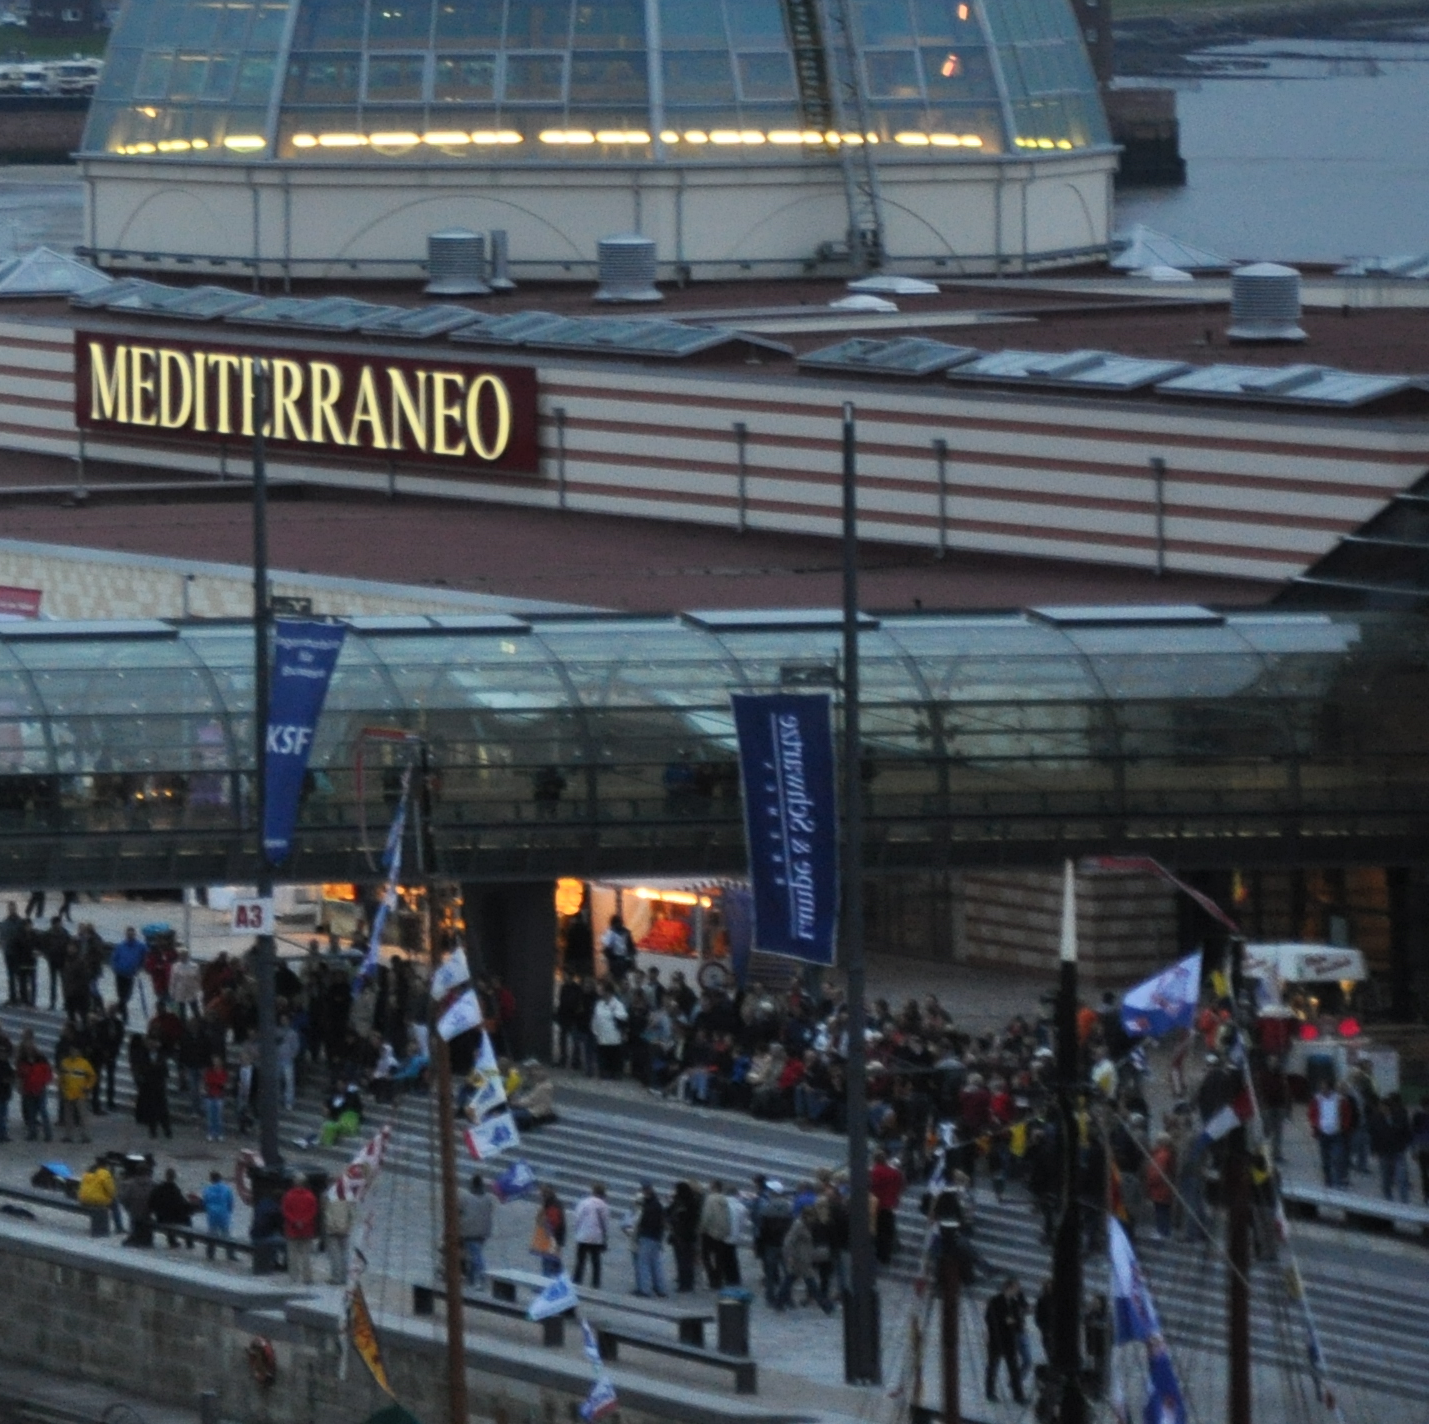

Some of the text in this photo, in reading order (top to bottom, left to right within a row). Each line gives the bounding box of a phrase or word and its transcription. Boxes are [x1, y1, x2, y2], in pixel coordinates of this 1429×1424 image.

[89, 341, 513, 462] MEDITERRANEO
[266, 724, 313, 755] KSF
[235, 904, 263, 929] A3
